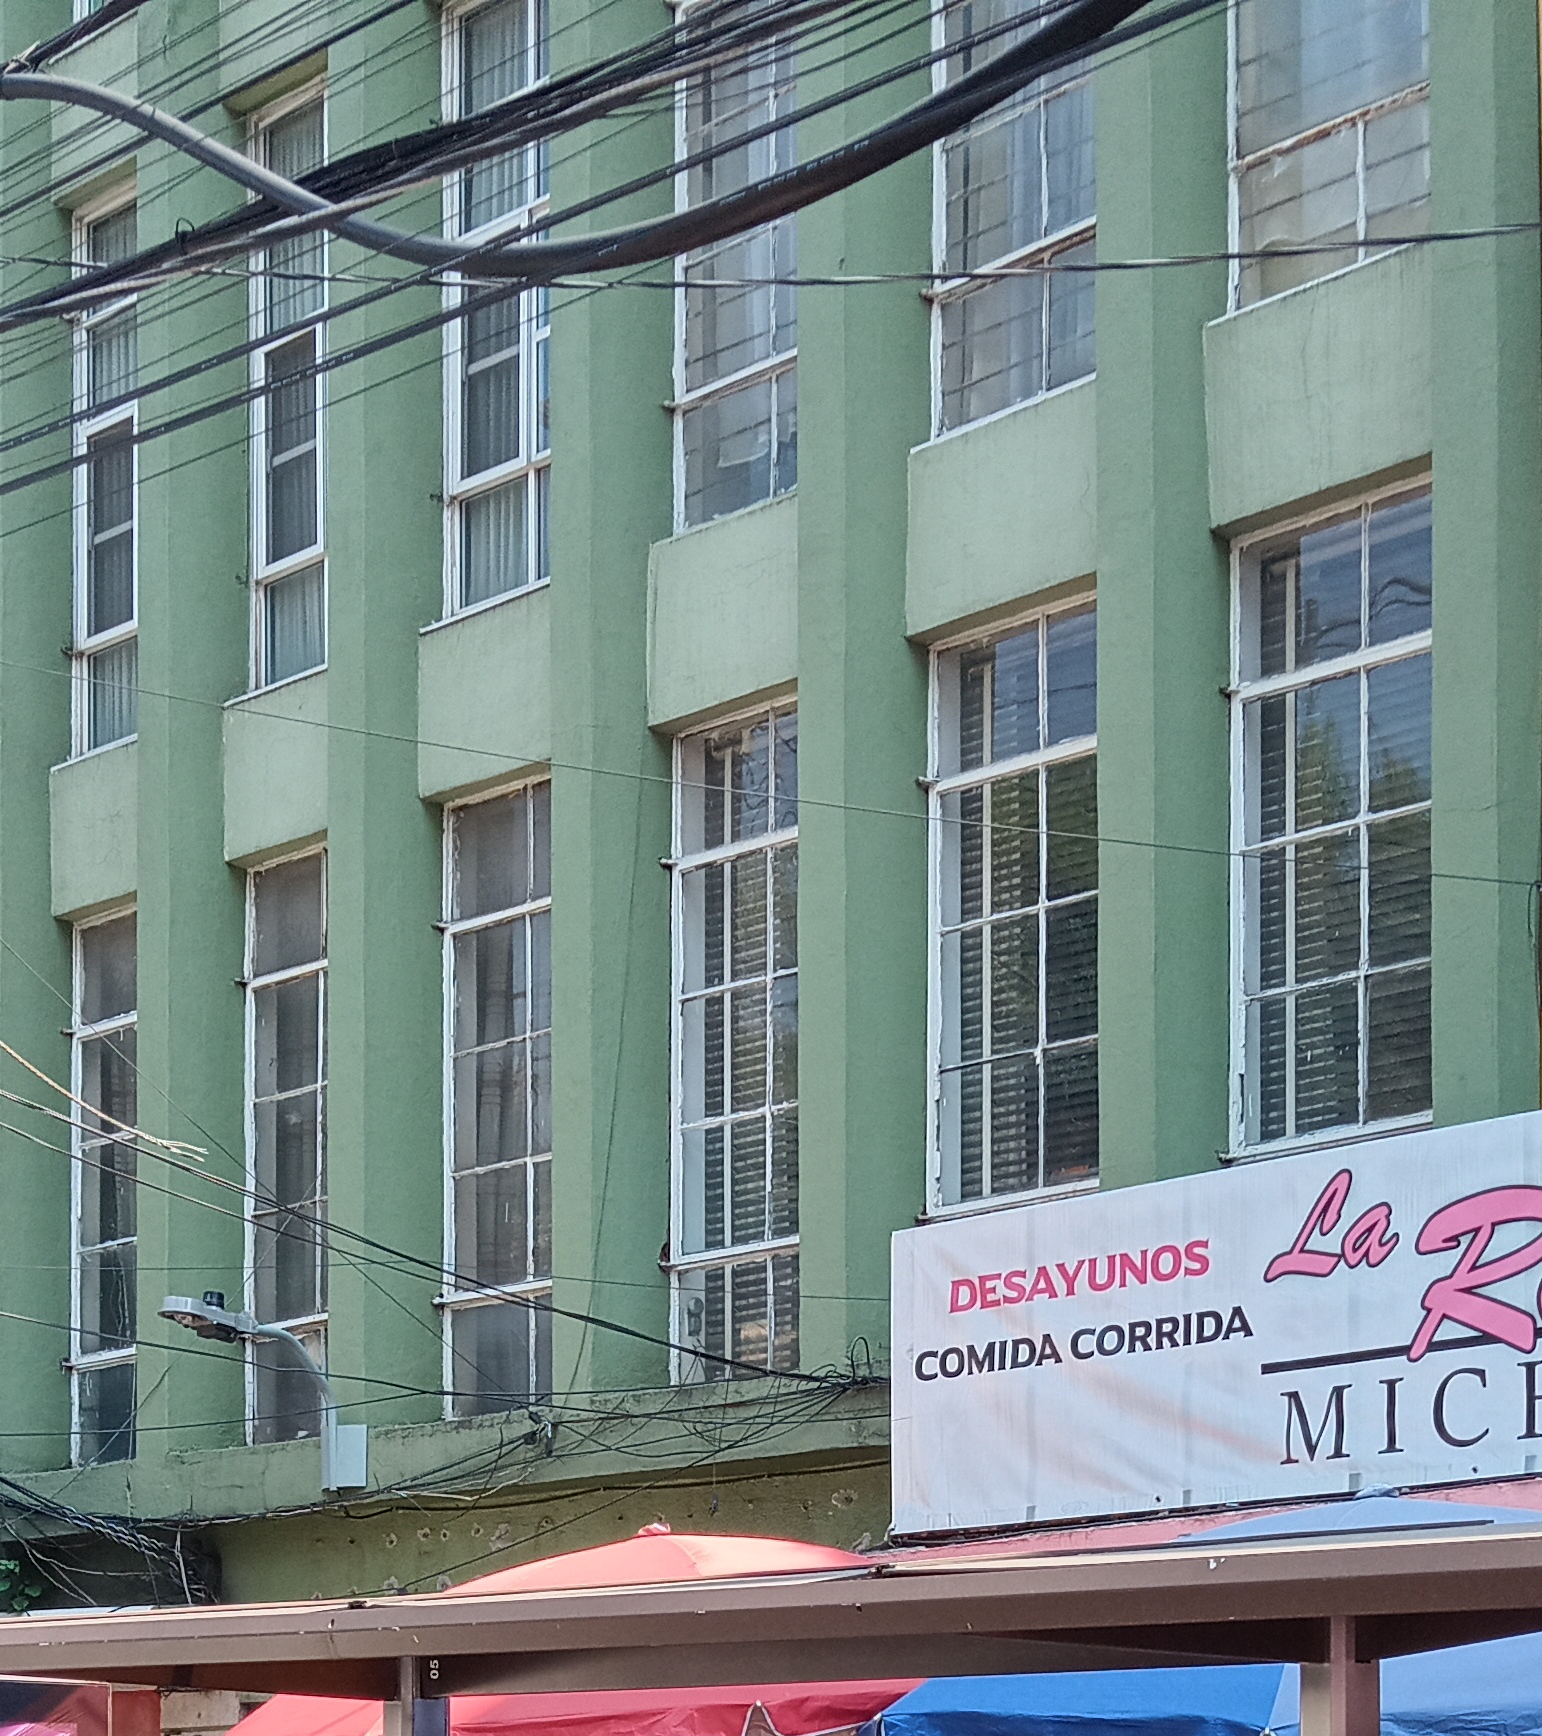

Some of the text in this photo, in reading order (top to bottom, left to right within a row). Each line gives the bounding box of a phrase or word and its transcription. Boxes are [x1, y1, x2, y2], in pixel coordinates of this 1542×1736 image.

[1264, 1169, 1400, 1283] La
[948, 1239, 1212, 1314] DESAYUNOS
[914, 1305, 1254, 1382] COMIDA CORRIDA
[430, 1660, 439, 1679] 05
